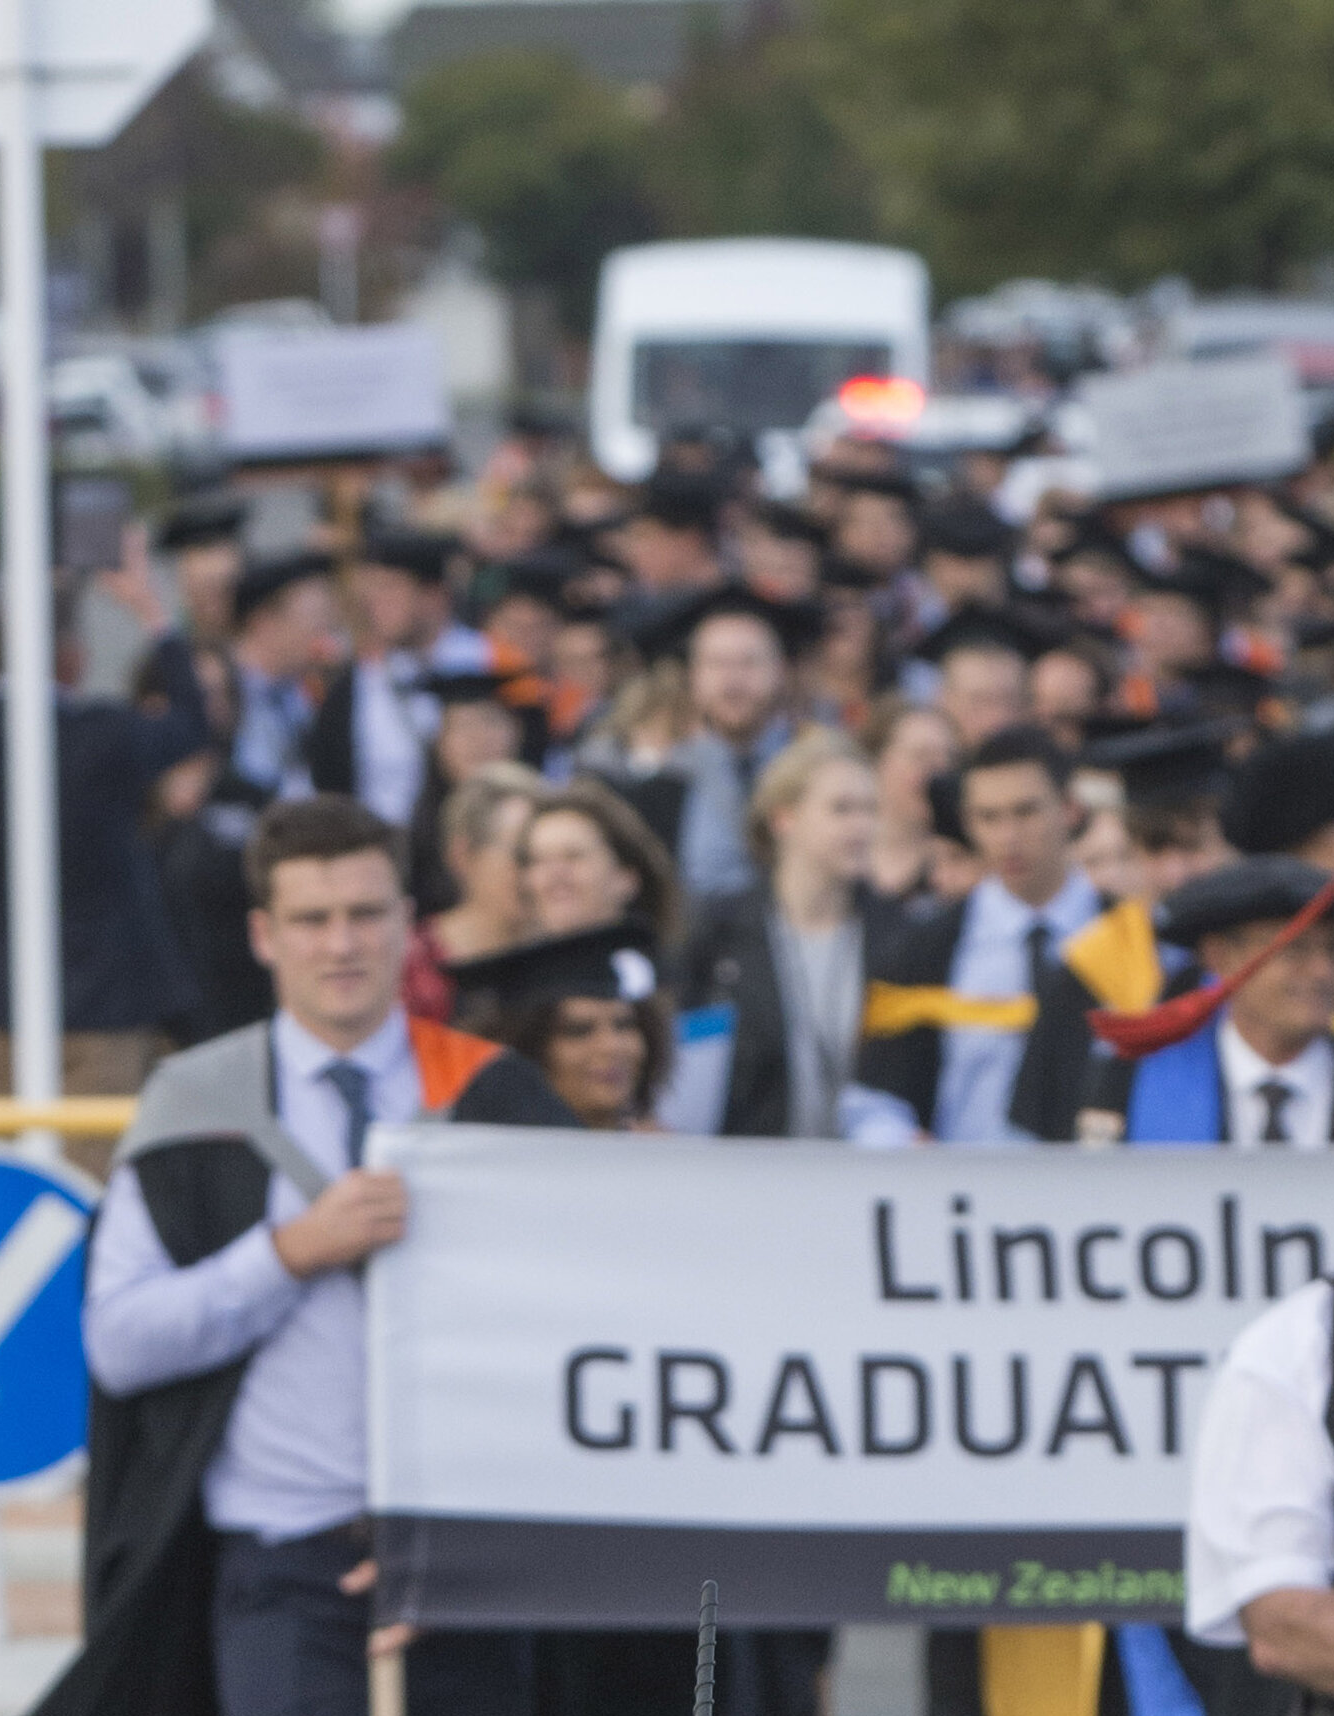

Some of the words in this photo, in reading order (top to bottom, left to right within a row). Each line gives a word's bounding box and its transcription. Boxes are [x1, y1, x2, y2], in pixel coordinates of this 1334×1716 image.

[873, 1195, 1325, 1302] Lincoln
[563, 1346, 1207, 1458] GRADUAT
[886, 1559, 1002, 1606] New
